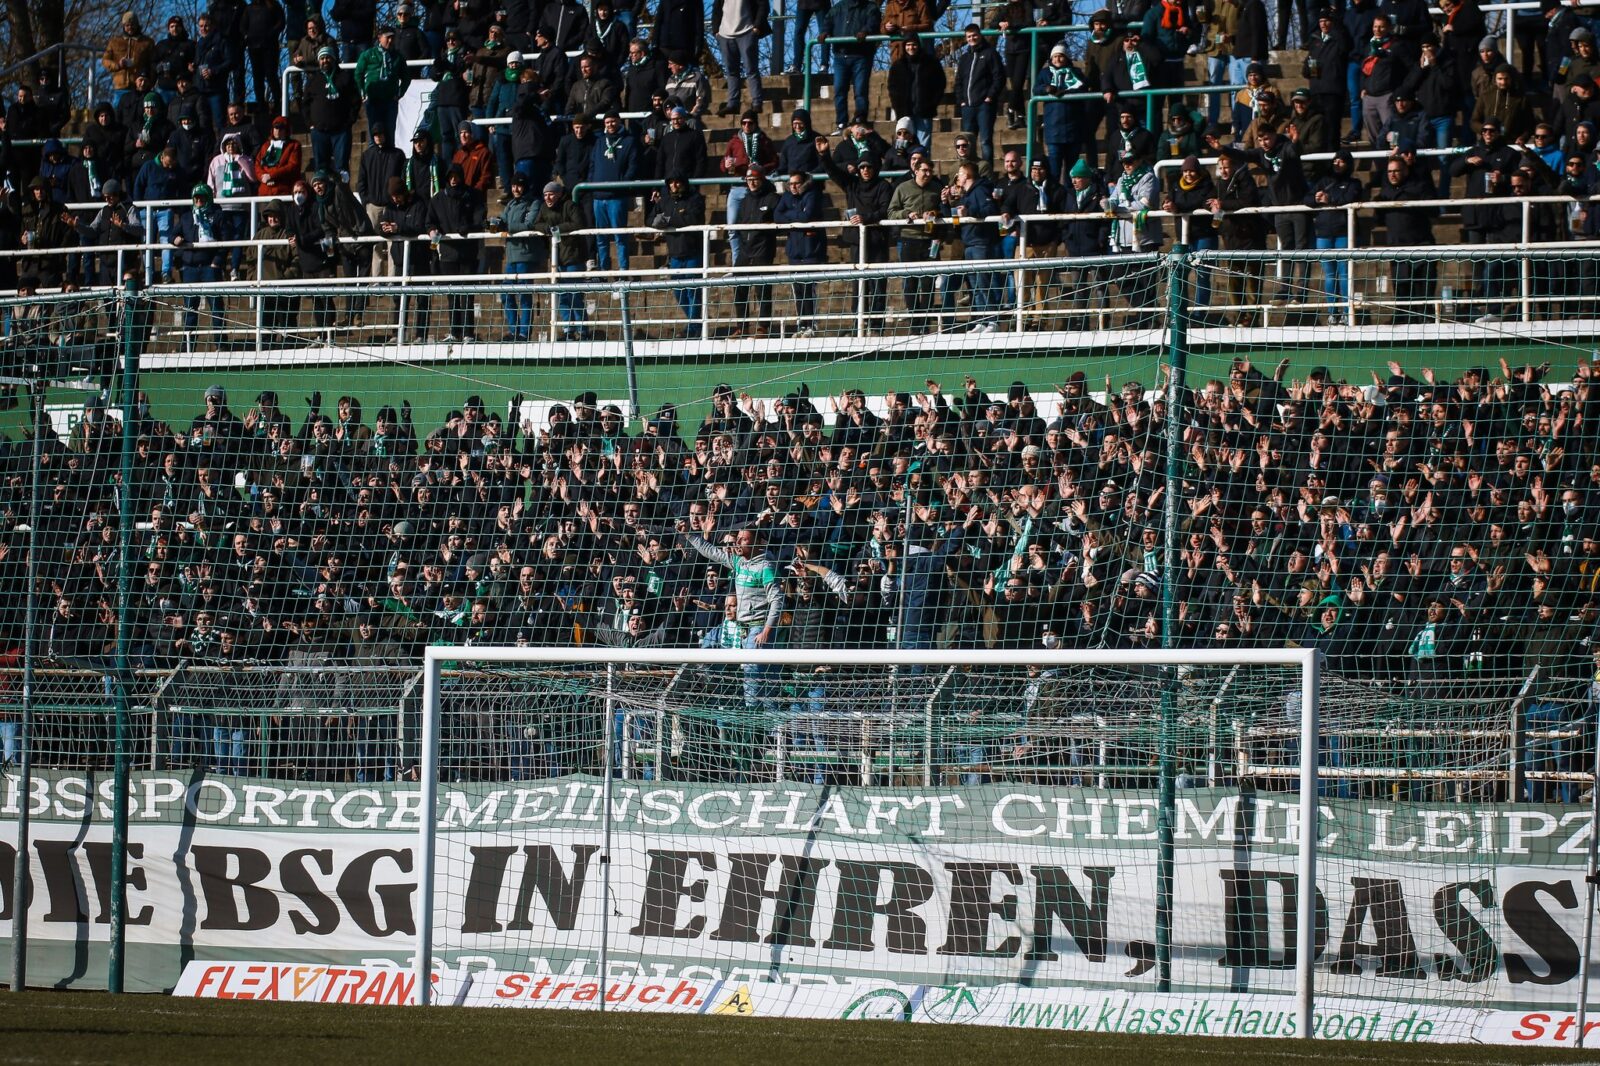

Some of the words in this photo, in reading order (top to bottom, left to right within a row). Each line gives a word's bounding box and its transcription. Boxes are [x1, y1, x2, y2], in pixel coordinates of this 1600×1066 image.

[991, 793, 1339, 848] CHEMIE
[191, 845, 418, 937] BSG
[461, 844, 600, 933] IN
[630, 849, 1156, 978] EHREN,
[1218, 869, 1581, 985] DASS
[496, 974, 703, 1006] Strauch.
